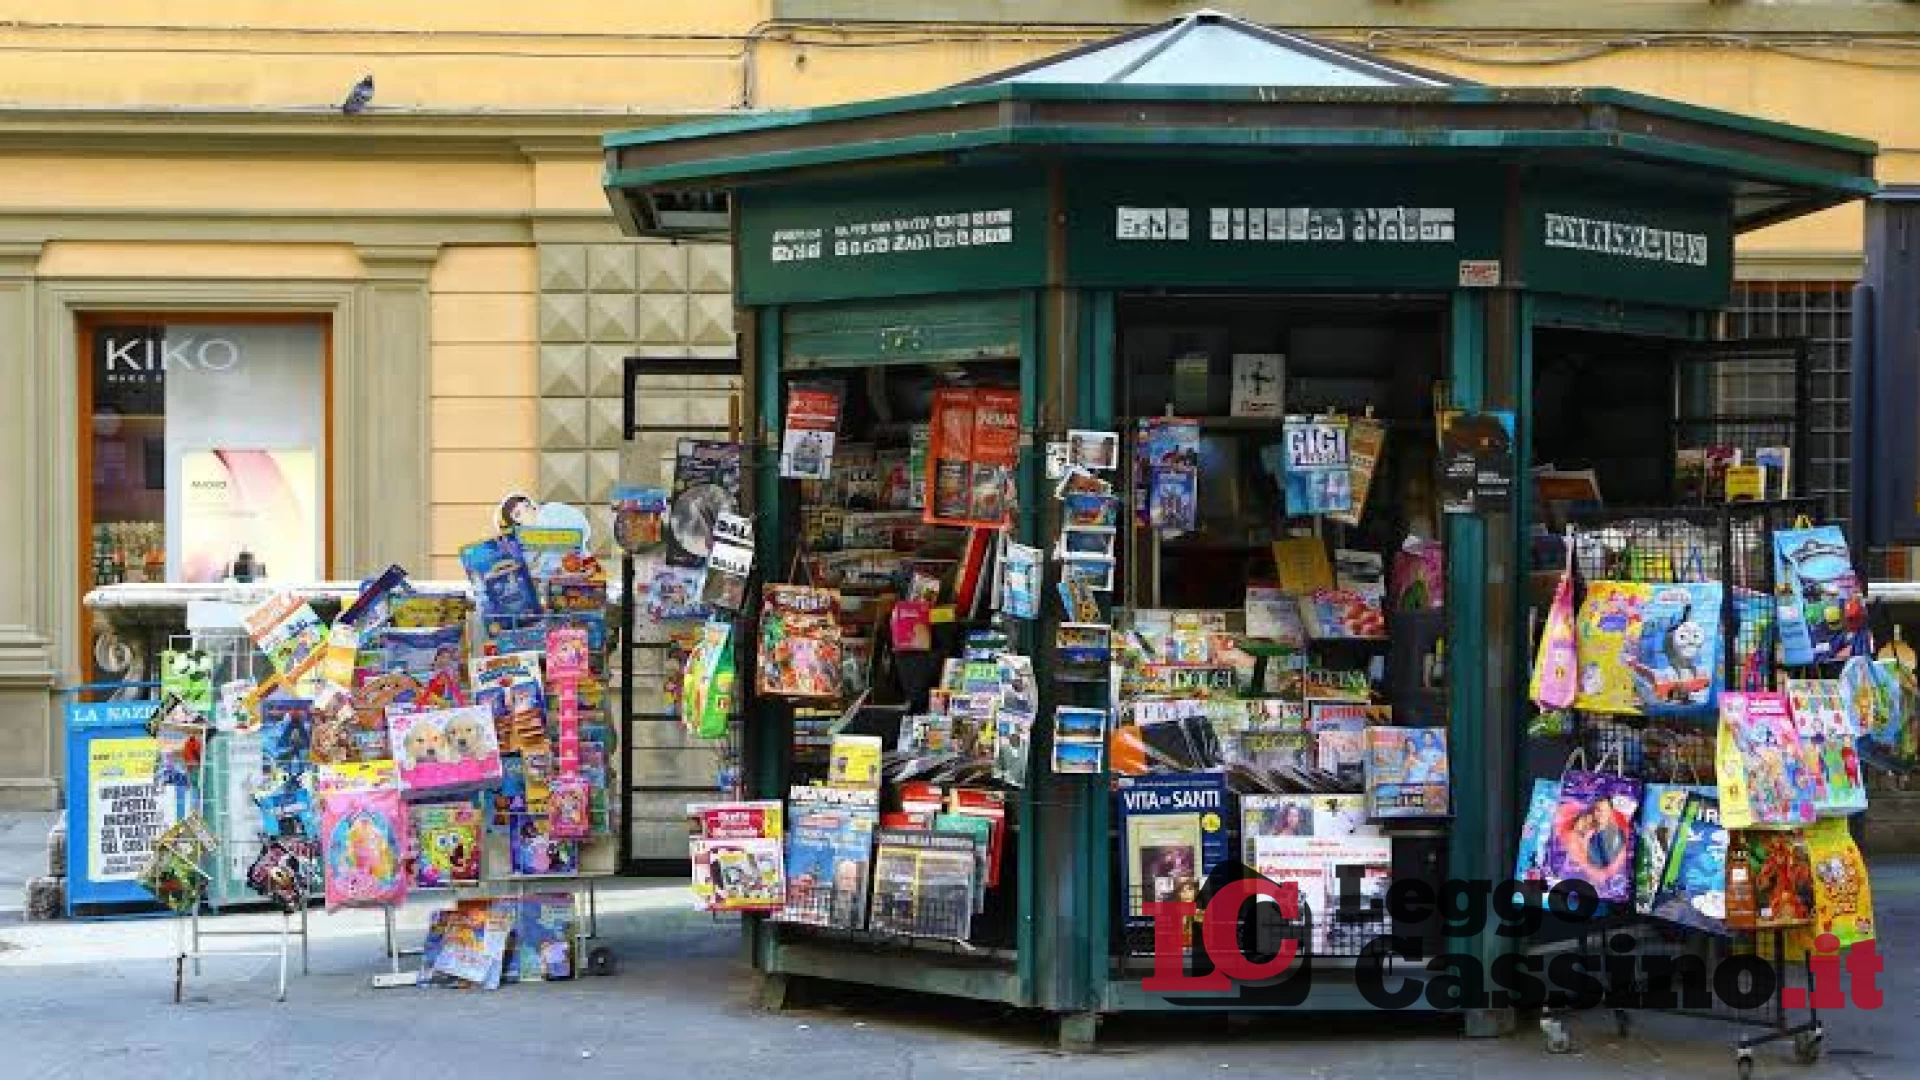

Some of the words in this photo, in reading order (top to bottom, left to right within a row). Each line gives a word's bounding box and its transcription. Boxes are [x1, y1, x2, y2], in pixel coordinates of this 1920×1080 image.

[106, 338, 238, 371] KIKO
[73, 707, 98, 722] LA
[1124, 791, 1160, 810] VITA
[1172, 791, 1220, 809] SANTI
